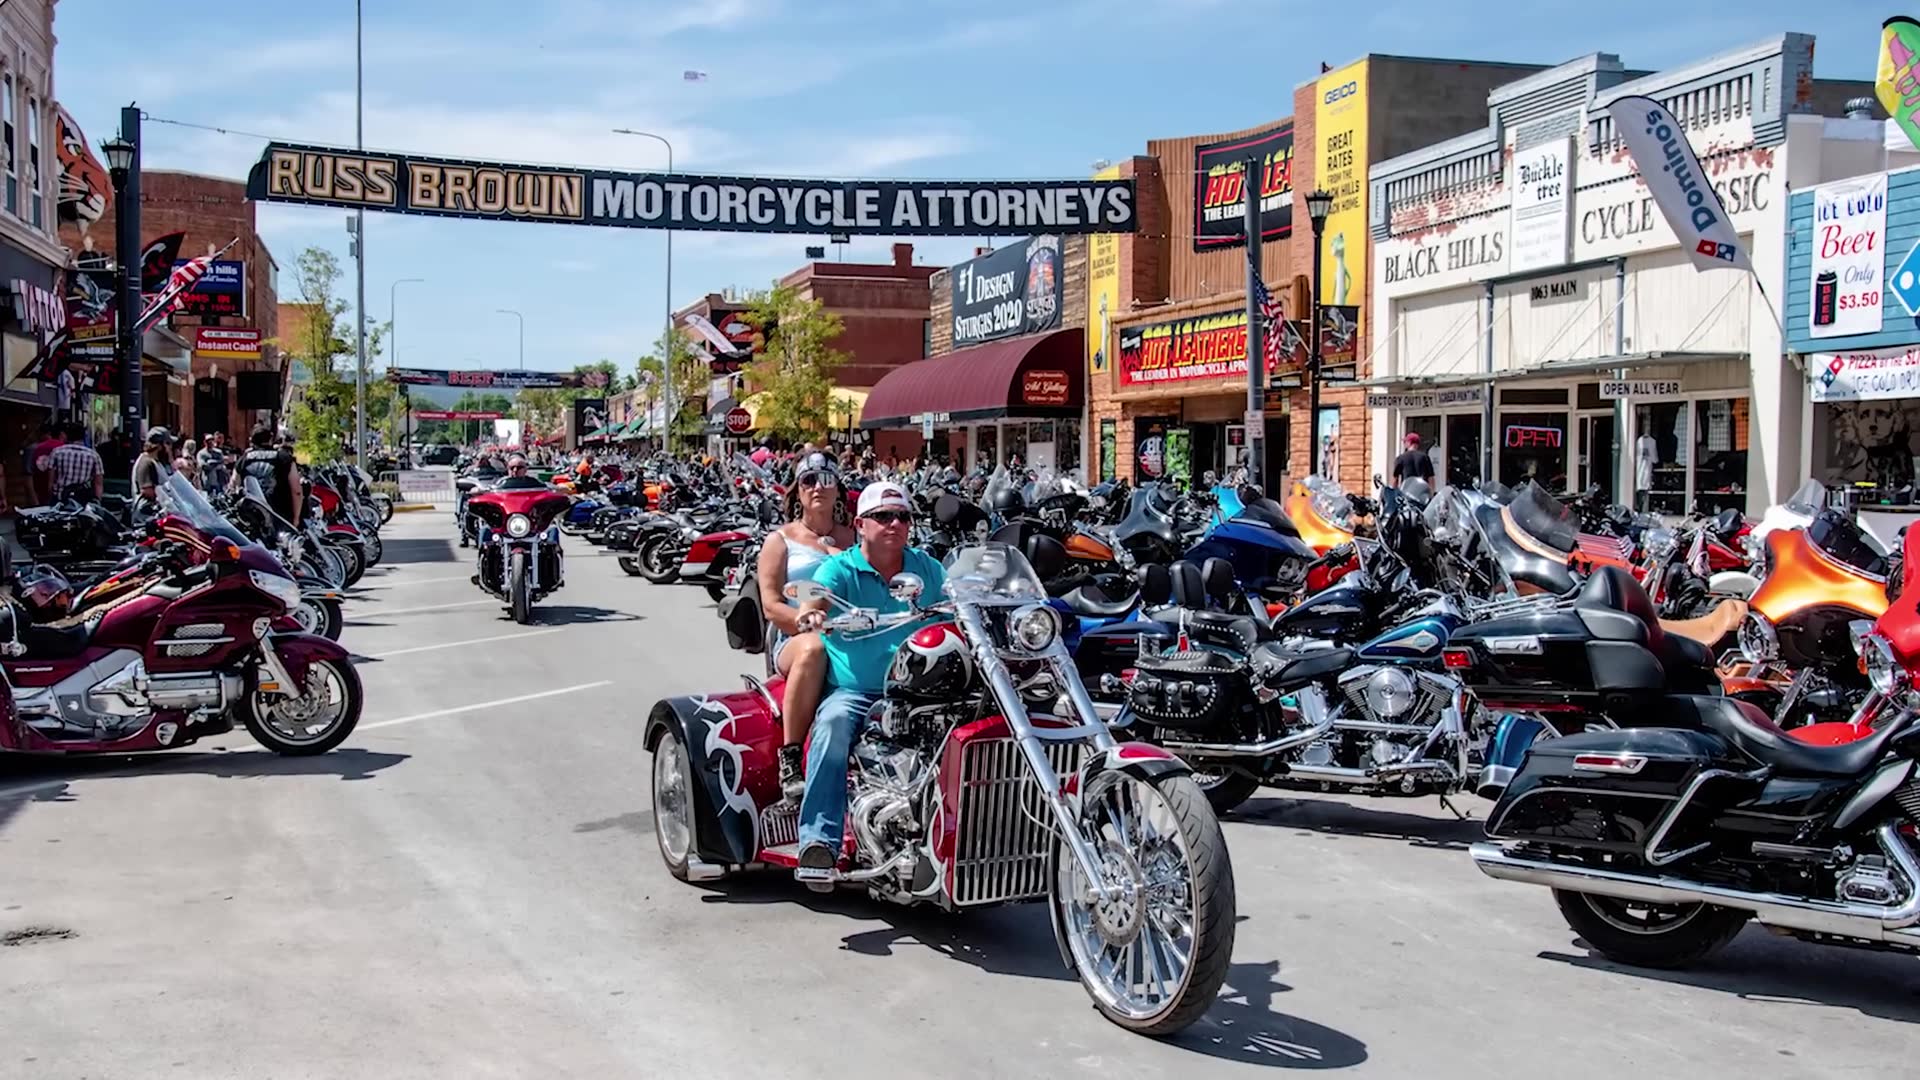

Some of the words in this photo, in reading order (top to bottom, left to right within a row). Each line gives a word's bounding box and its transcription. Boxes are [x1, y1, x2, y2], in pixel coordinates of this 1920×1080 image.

[1324, 81, 1357, 105] GEICO
[1327, 129, 1353, 153] GREAT
[1327, 150, 1353, 172] RATES
[1646, 109, 1718, 233] Domino's
[1518, 153, 1563, 194] Buckle
[269, 150, 398, 206] RUSS
[409, 162, 585, 219] BROWN
[593, 178, 882, 227] MOTORCYCLE
[891, 186, 1132, 228] ATTORNEYS
[1537, 183, 1561, 200] tree
[1204, 207, 1223, 222] THE
[1223, 202, 1246, 219] LEAD
[1582, 197, 1655, 244] CYCLE
[1715, 172, 1770, 216] SSIC
[1818, 201, 1840, 222] ICE
[1847, 193, 1883, 217] COLD
[1820, 224, 1877, 259] Beer
[1384, 246, 1441, 284] BLACK
[1447, 231, 1503, 271] HILLS
[215, 265, 238, 275] hills
[1844, 262, 1876, 285] Only
[959, 263, 975, 306] #1
[976, 271, 1015, 303] DESIGN
[1531, 284, 1548, 302] 1063
[1550, 279, 1577, 299] MAIN
[18, 279, 66, 334] TATTOO
[1821, 284, 1832, 325] BEER
[1839, 291, 1879, 311] $3.50
[955, 312, 993, 341] STURGIS
[993, 298, 1023, 332] 2020
[1141, 335, 1171, 370] HOT
[1173, 324, 1249, 367] LEATHERS
[1131, 371, 1143, 382] THE
[1144, 368, 1168, 380] LEADER
[1170, 367, 1177, 378] IN
[1179, 361, 1227, 378] MOTORCYCLE
[1229, 358, 1248, 374] APPA
[1848, 354, 1878, 370] PIZZA
[1604, 383, 1630, 396] OPEN
[1633, 383, 1650, 395] ALL
[1653, 382, 1679, 395] YEAR
[1368, 396, 1402, 407] FACTORY
[728, 415, 750, 426] STOP
[1508, 427, 1561, 449] OPEN
